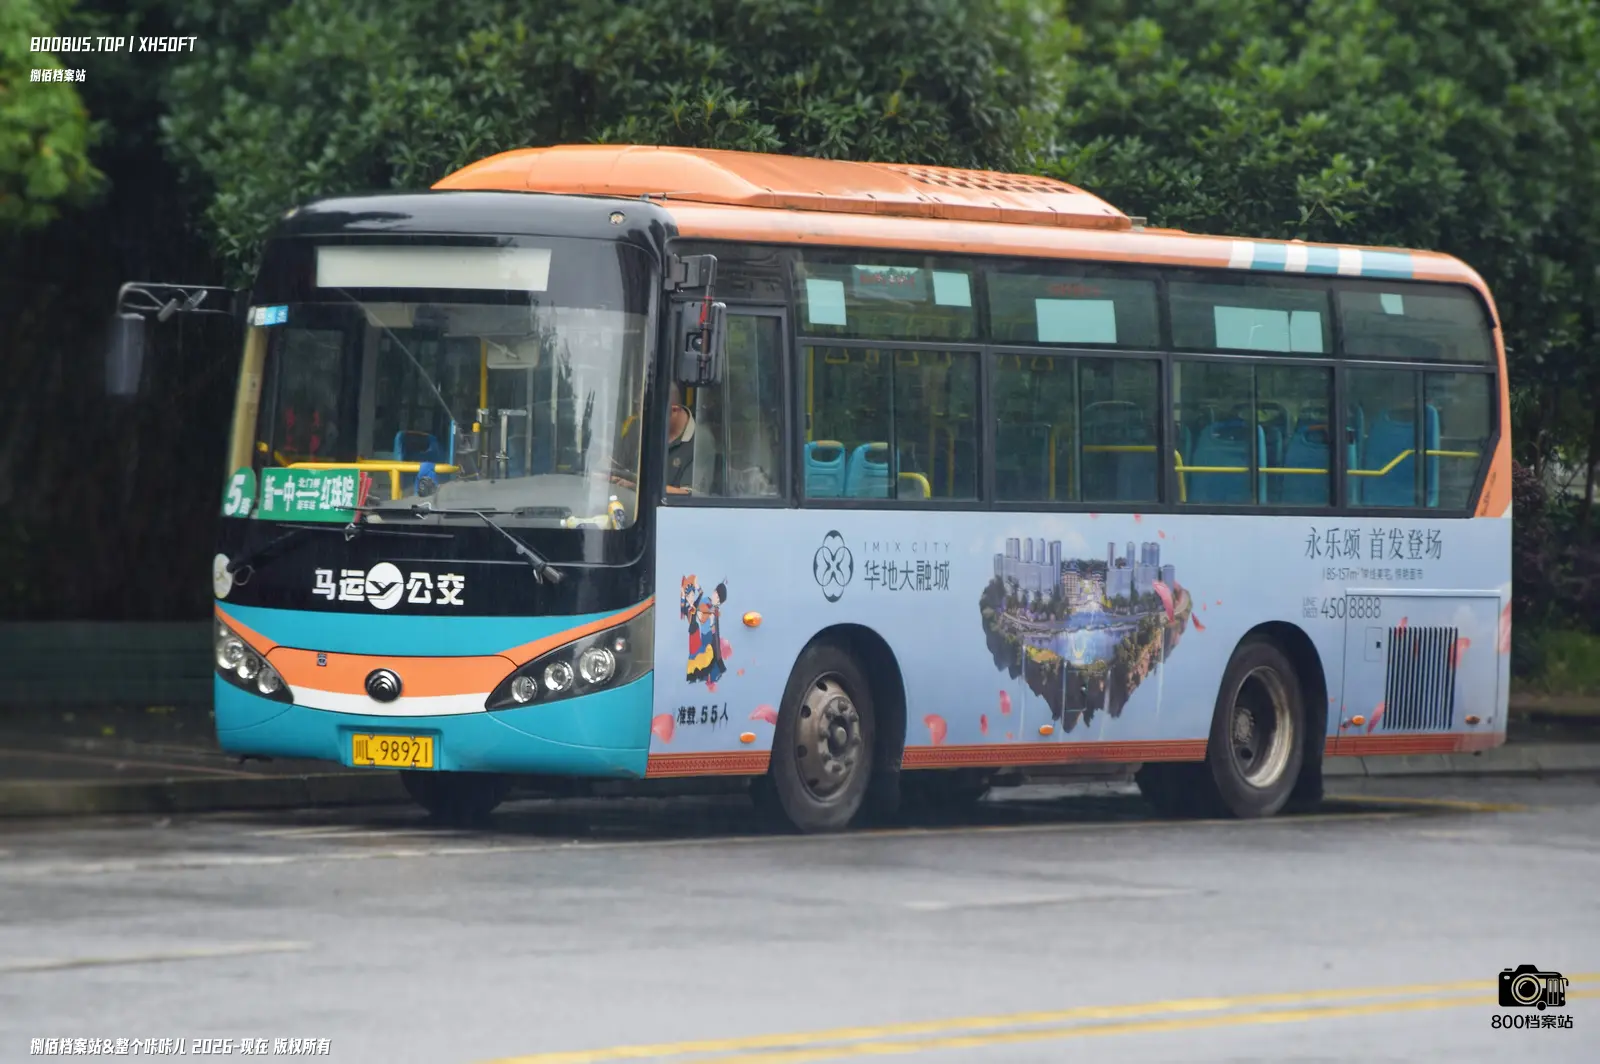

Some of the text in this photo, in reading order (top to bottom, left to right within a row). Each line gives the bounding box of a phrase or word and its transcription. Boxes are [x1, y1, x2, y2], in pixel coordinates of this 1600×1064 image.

[864, 541, 951, 554] IMIX CITY
[1304, 527, 1443, 560] 永乐颂 首发登场
[312, 568, 465, 606] 马运 公交
[864, 559, 950, 592] 华地大融城
